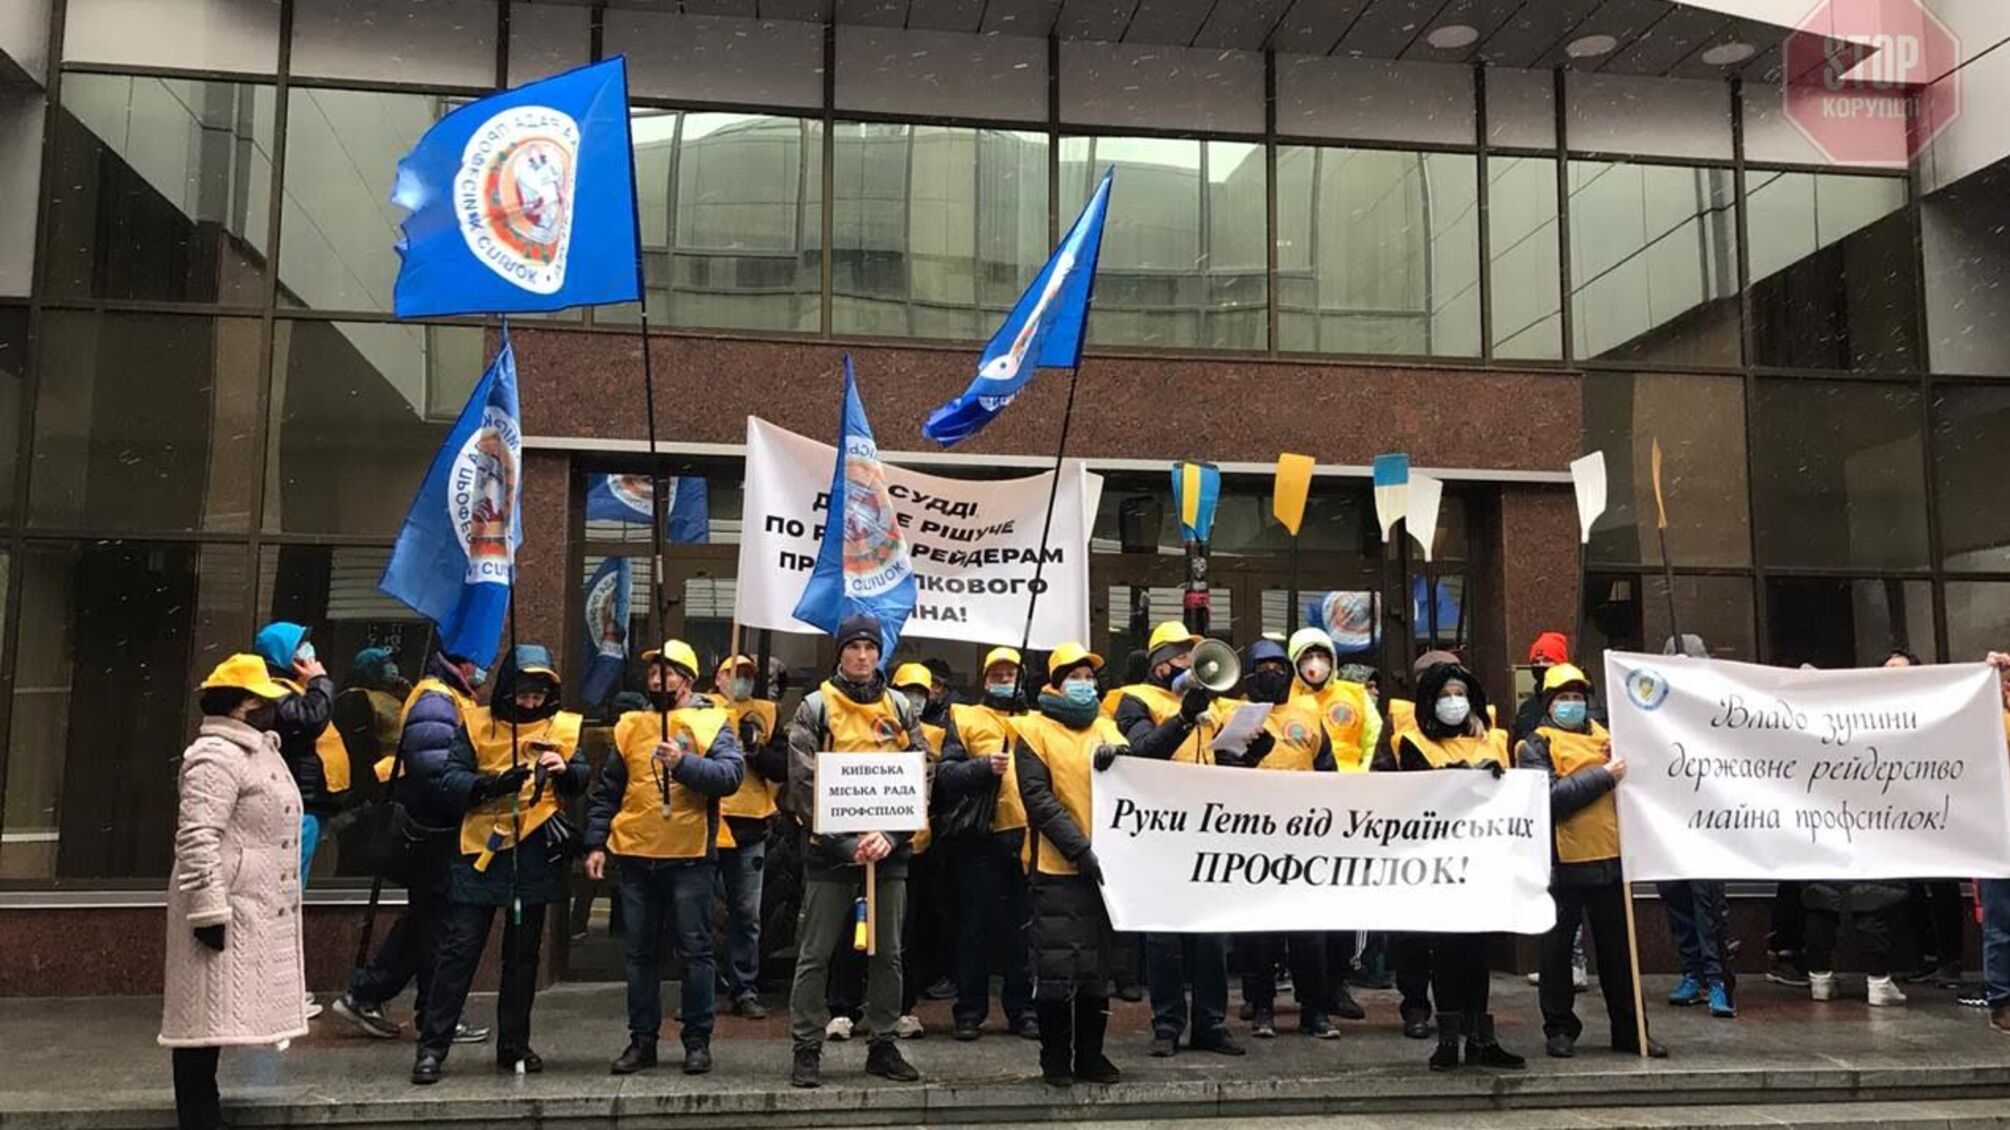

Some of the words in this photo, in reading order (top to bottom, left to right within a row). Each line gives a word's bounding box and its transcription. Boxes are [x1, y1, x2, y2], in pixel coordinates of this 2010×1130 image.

[888, 484, 978, 519] СУДДІ
[765, 515, 805, 538] ПО
[919, 519, 1015, 543] РІШУЧЕ
[911, 543, 1063, 569] РЕЙДЕРАМ
[1711, 694, 1808, 730] Владо
[1821, 711, 1918, 746] зупини
[841, 765, 904, 776] КИЇВСЬКА
[1668, 742, 1797, 793] державне
[1807, 746, 1965, 795] рейдерство
[829, 786, 877, 797] МІСЬКА
[883, 785, 916, 796] РАДА
[830, 806, 914, 818] ПРОФСПІЛОК
[1110, 798, 1188, 838] Руки
[1199, 802, 1277, 836] Геть
[1286, 807, 1333, 838] від
[1342, 809, 1534, 847] Українських
[1687, 803, 1781, 830] майна
[1795, 794, 1950, 844] профспілок!
[1189, 851, 1470, 887] ПРОФСПІЛОК!
